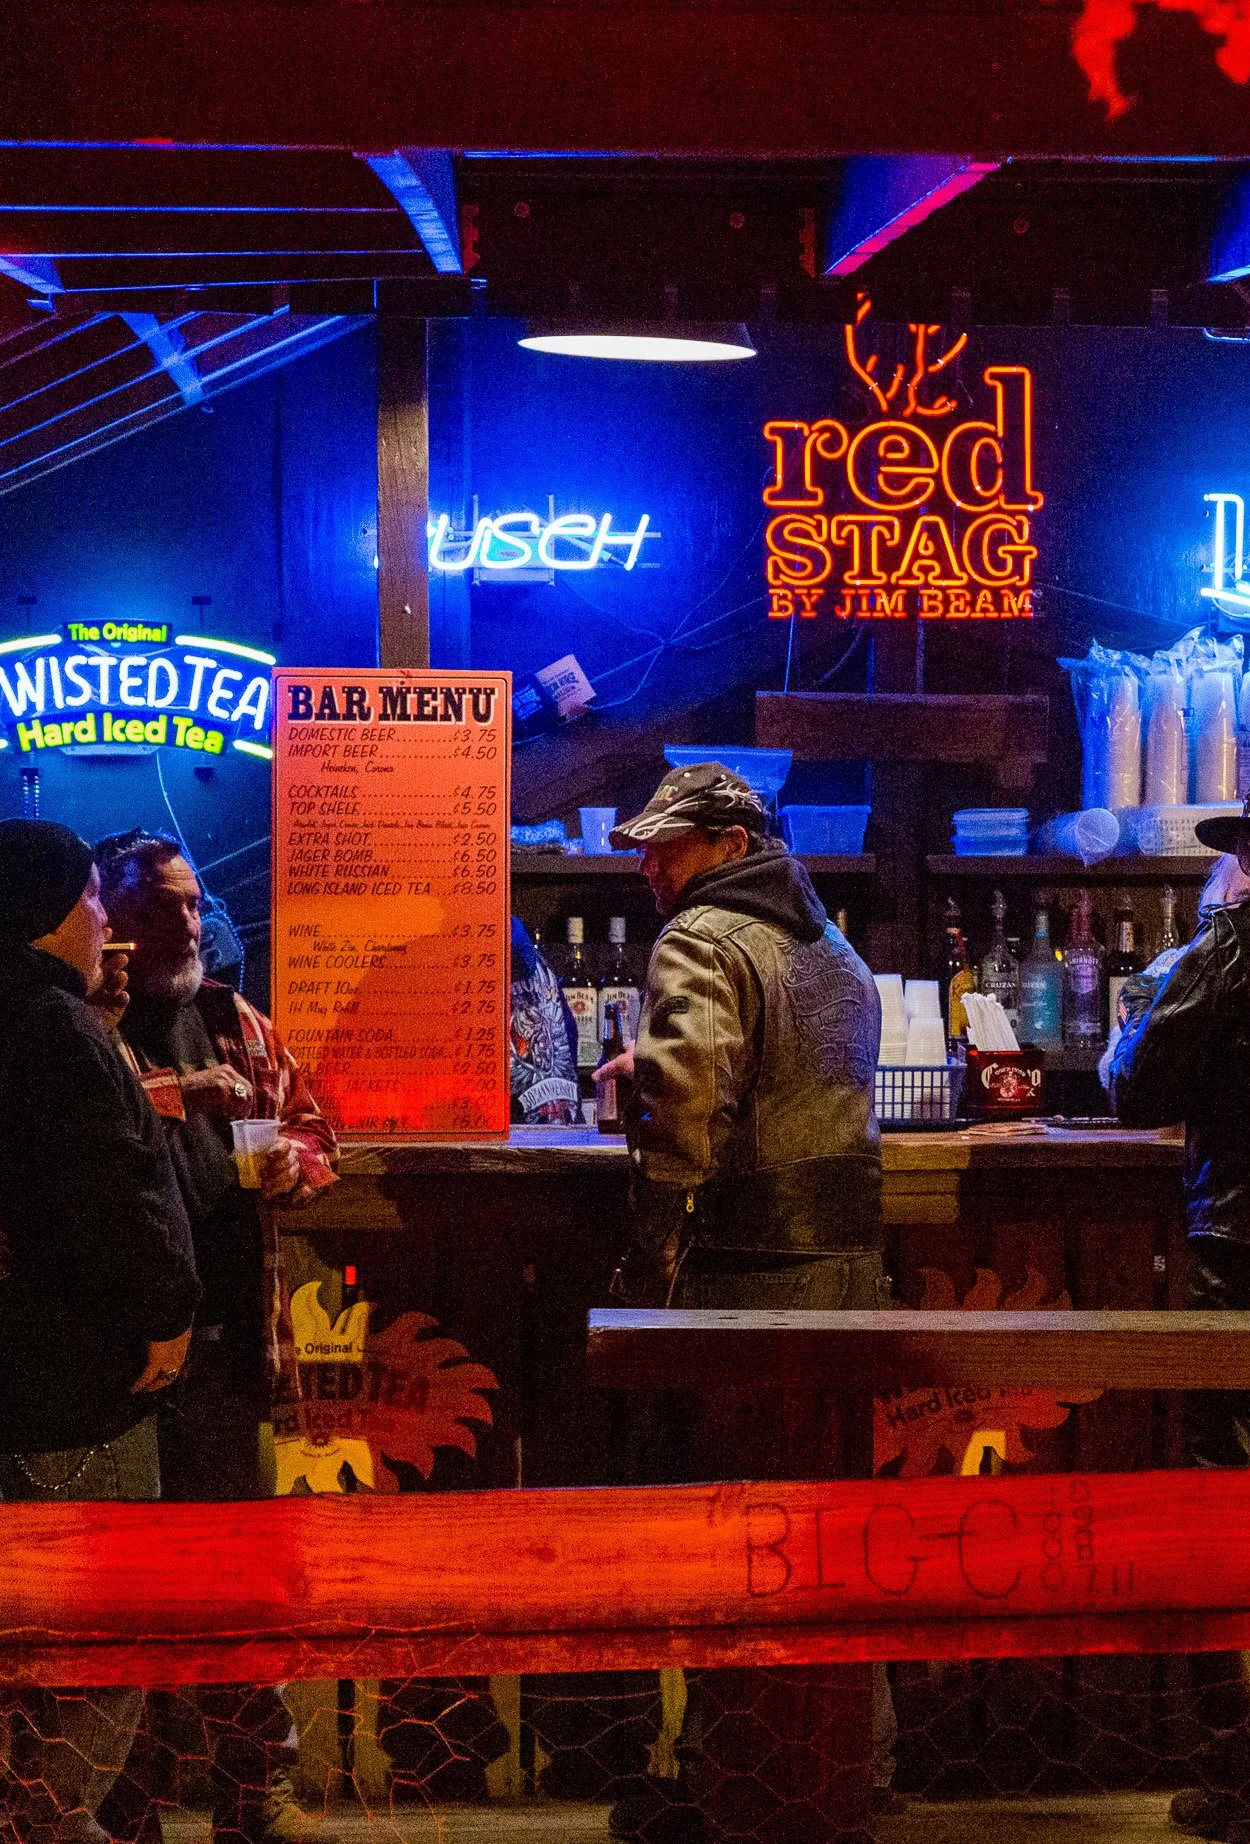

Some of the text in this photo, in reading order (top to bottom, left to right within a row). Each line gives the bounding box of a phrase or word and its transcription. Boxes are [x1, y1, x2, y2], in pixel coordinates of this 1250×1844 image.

[763, 364, 1044, 512] red
[428, 512, 651, 571] USCH
[766, 513, 1038, 586] STAG
[768, 588, 1034, 619] BY JIM BEAM
[67, 622, 168, 643] The Original
[183, 654, 270, 731] TEA
[287, 685, 373, 723] BAR
[379, 686, 497, 724] MENU
[17, 711, 225, 755] Hard Iced Tea
[288, 728, 497, 742] DOMESTIC BEER $3.75
[288, 744, 497, 760] IMPORT BEER $4.50
[288, 785, 496, 799] COCKTAILS $4.75
[289, 802, 497, 816] TOP SHELF $5.50
[288, 833, 497, 846] EXTRA SHOT $2.50
[287, 850, 497, 863] JAGER BOMB $6.50
[288, 865, 497, 878] WHITE RUSSIAN $6.50
[287, 880, 497, 896] LONG ISLAND ICED TEA $8.50
[288, 924, 496, 937] WINE $3.75
[288, 954, 496, 969] WINE COOLERS $3.75
[288, 980, 496, 995] DRAFT $1.75
[287, 1029, 353, 1043] FOUNTAIN
[359, 1028, 394, 1042] SODA
[304, 1342, 353, 1355] Original
